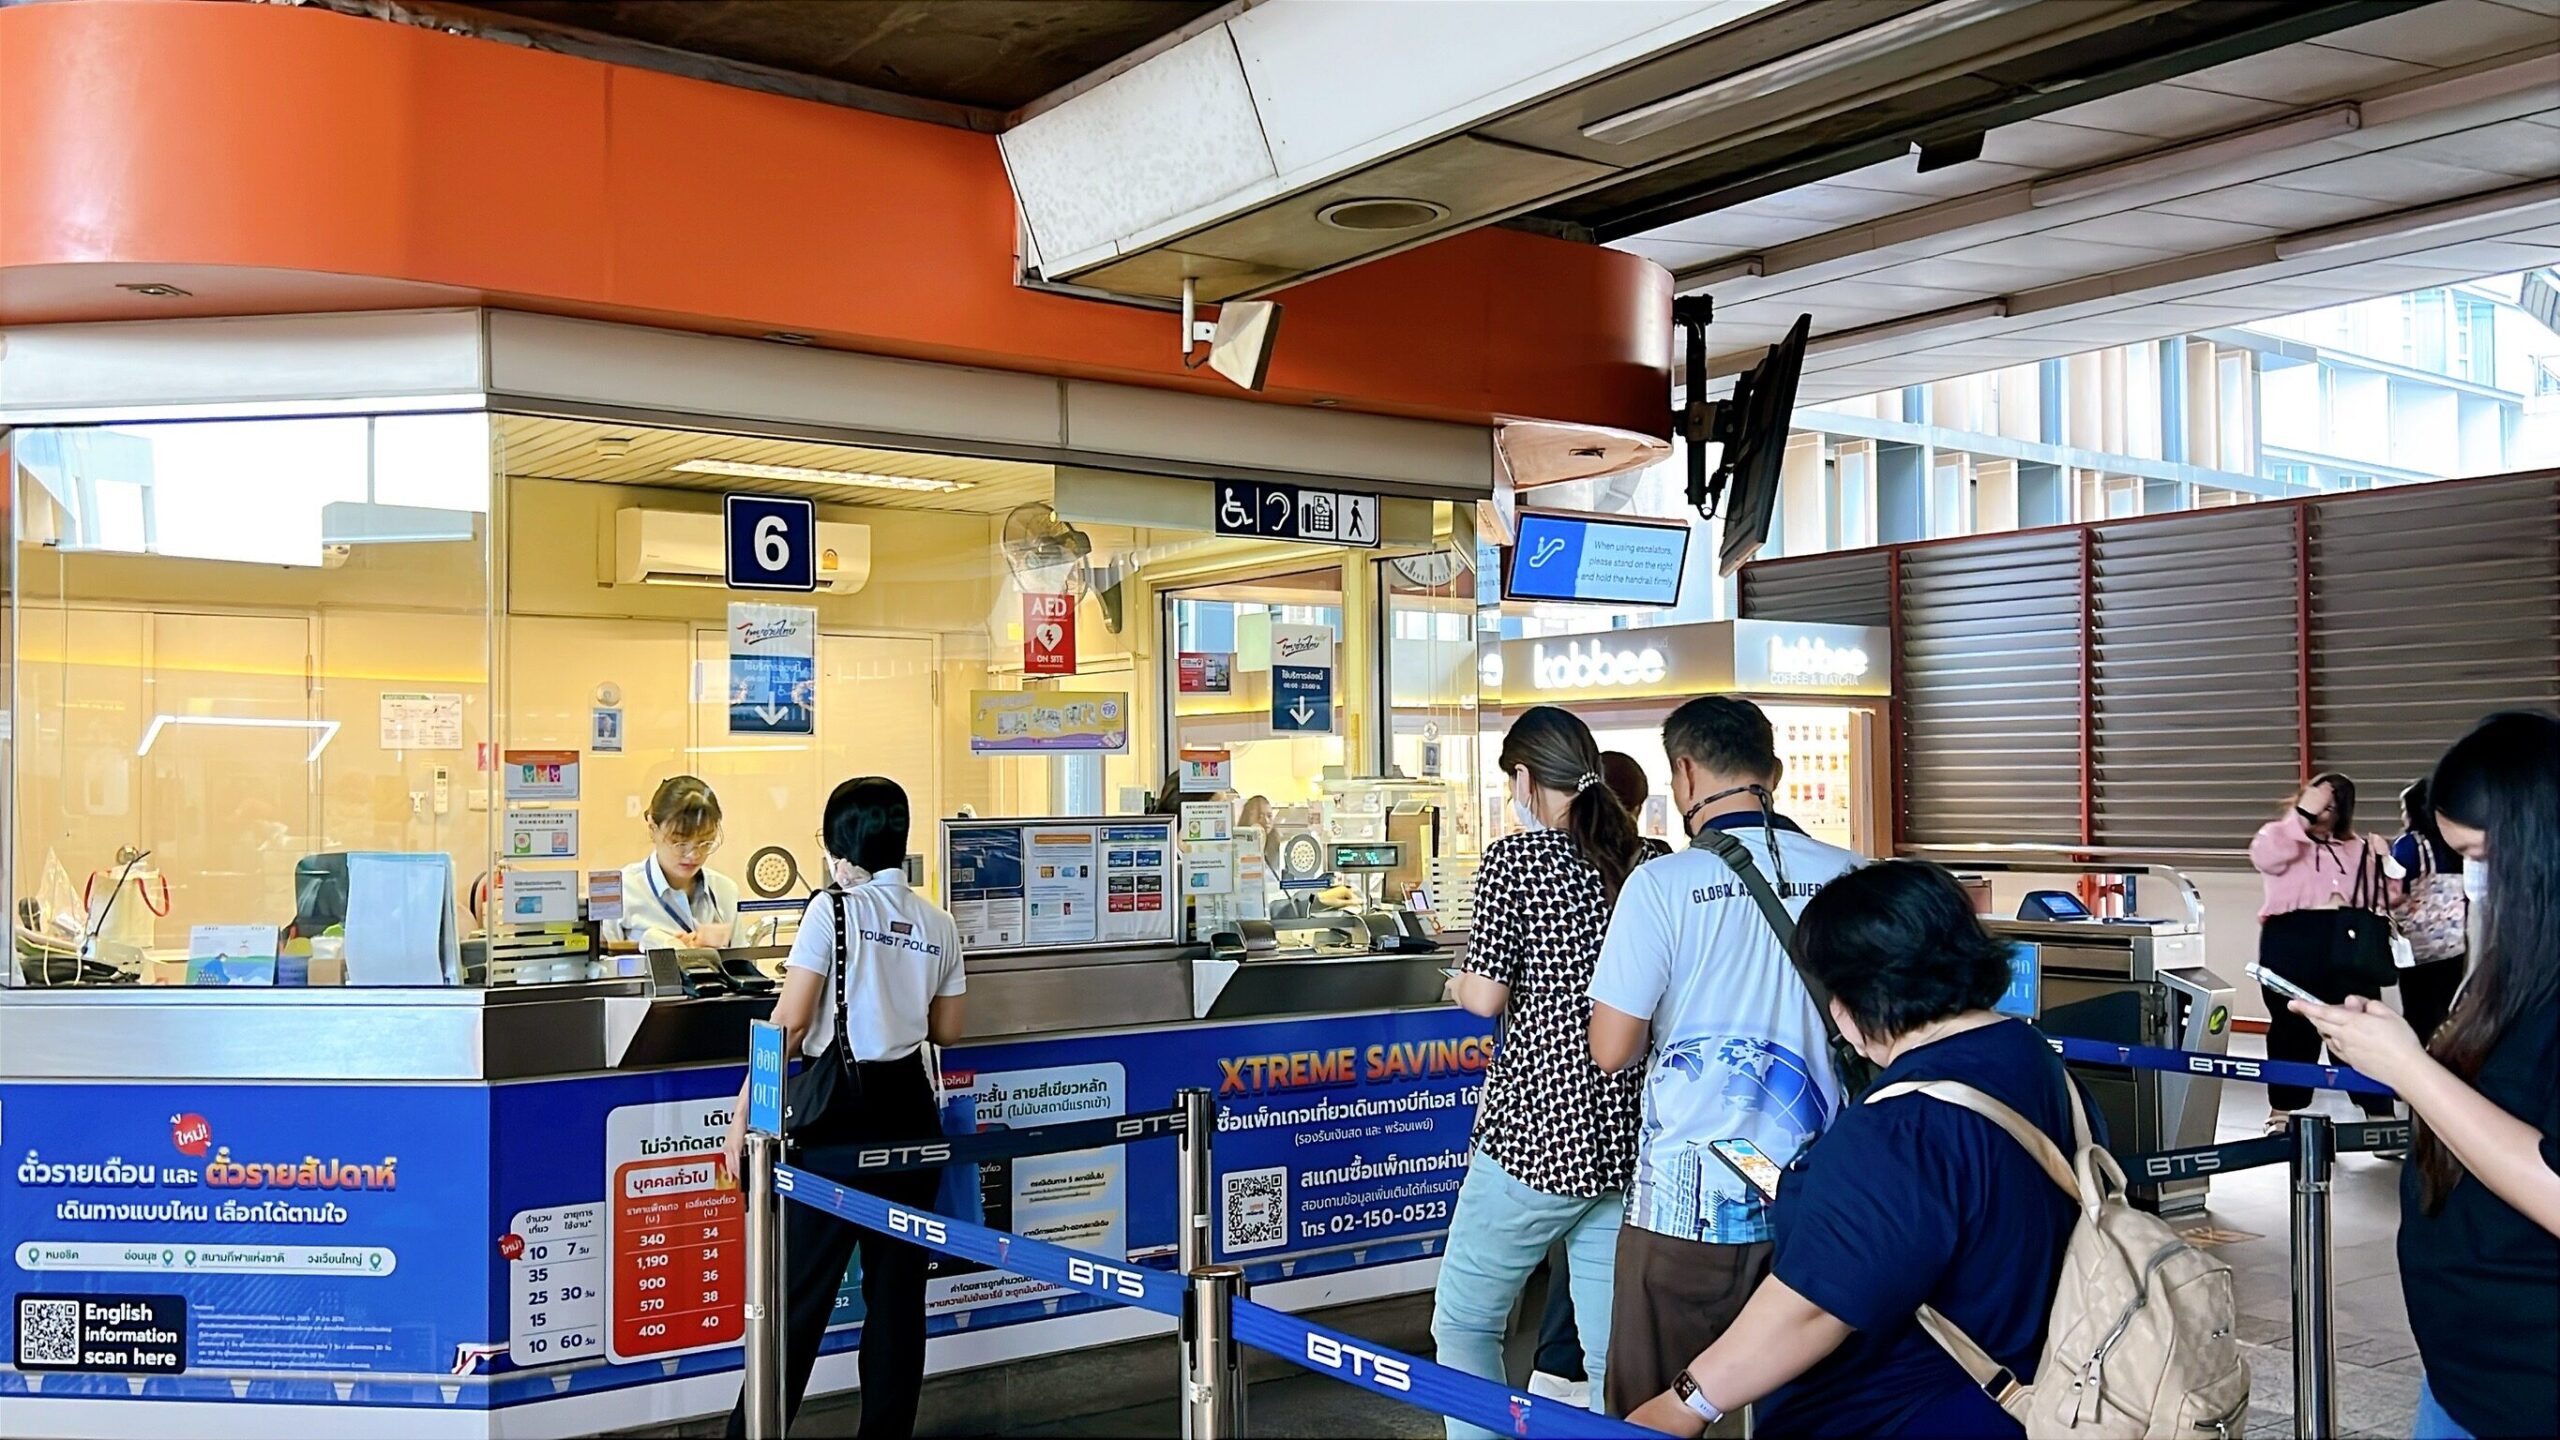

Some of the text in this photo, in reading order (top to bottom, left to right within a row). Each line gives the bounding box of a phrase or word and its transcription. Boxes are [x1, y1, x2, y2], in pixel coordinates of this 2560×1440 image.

[754, 515, 790, 571] 6
[1594, 540, 1614, 550] When
[1616, 543, 1635, 554] using
[1589, 557, 1674, 572] please stand on the right
[1580, 572, 1594, 581] and
[1596, 573, 1610, 582] hold
[1612, 574, 1624, 583] the
[1625, 575, 1653, 585] handrail
[1032, 597, 1067, 617] AED
[1036, 655, 1064, 664] ON SITE
[1533, 639, 1667, 689] kobbee
[1769, 672, 1860, 686] COFFEE & MATCHA
[902, 938, 941, 956] POLICE
[756, 1047, 778, 1073] ออก
[1218, 1035, 1494, 1096] XTREME SAVINGS
[2189, 1056, 2261, 1078] BTS
[753, 1081, 779, 1109] OUT
[1012, 1078, 1108, 1101] สายสีเขียวหลัก
[1007, 1095, 1111, 1120] (ไม่นับสถานีแรกเข้า)
[1217, 1089, 1456, 1132] ซื้อแพ็กเกจเที่ยวเดินทางบีทีเอส
[1116, 1113, 1187, 1138] BTS
[1295, 1117, 1434, 1147] (รองรับเงินสด และ พร้อมเพย์)
[176, 1123, 209, 1146] ใหม่!
[2363, 1126, 2409, 1146] BTS
[858, 1143, 951, 1168] BTS
[2147, 1151, 2221, 1177] BTS
[17, 1146, 398, 1189] ตั๋วรายเดือน และ ตั๋วรายสัปดาห์
[633, 1168, 708, 1194] บุคคลทั่วไป
[56, 1199, 348, 1224] เดินทางแบบไหน เลือกได้ตามใจ
[563, 1209, 594, 1222] อายุการ
[626, 1202, 680, 1216] ราคาแพ็กเกจ
[525, 1214, 552, 1224] จำนวน
[888, 1207, 947, 1244] BTS
[1301, 1200, 1448, 1238] โทร 02-150-0523
[528, 1223, 549, 1235] เที่ยว
[703, 1227, 719, 1239] 34
[639, 1233, 666, 1247] 340
[46, 1249, 363, 1266] หมอชิต อ่อนนุช สนามกีฬาแห่งชาติ วงเวียนใหญ่
[529, 1246, 548, 1261] 10
[567, 1242, 577, 1256] 7
[702, 1248, 718, 1260] 34
[636, 1254, 669, 1270] 1,190
[528, 1268, 549, 1283] 35
[639, 1277, 666, 1291] 900
[703, 1270, 719, 1282] 36
[1068, 1256, 1145, 1299] BTS
[528, 1291, 549, 1306] 25
[560, 1286, 582, 1301] 30
[702, 1291, 718, 1303] 38
[834, 1296, 850, 1308] 32
[640, 1298, 665, 1312] 570
[85, 1303, 153, 1326] English
[529, 1312, 547, 1328] 15
[701, 1316, 719, 1328] 40
[85, 1326, 178, 1344] information
[638, 1323, 666, 1337] 400
[528, 1339, 548, 1354] 10
[560, 1333, 583, 1350] 60
[84, 1351, 128, 1366] scan
[133, 1347, 177, 1367] here
[1305, 1331, 1411, 1392] BTS
